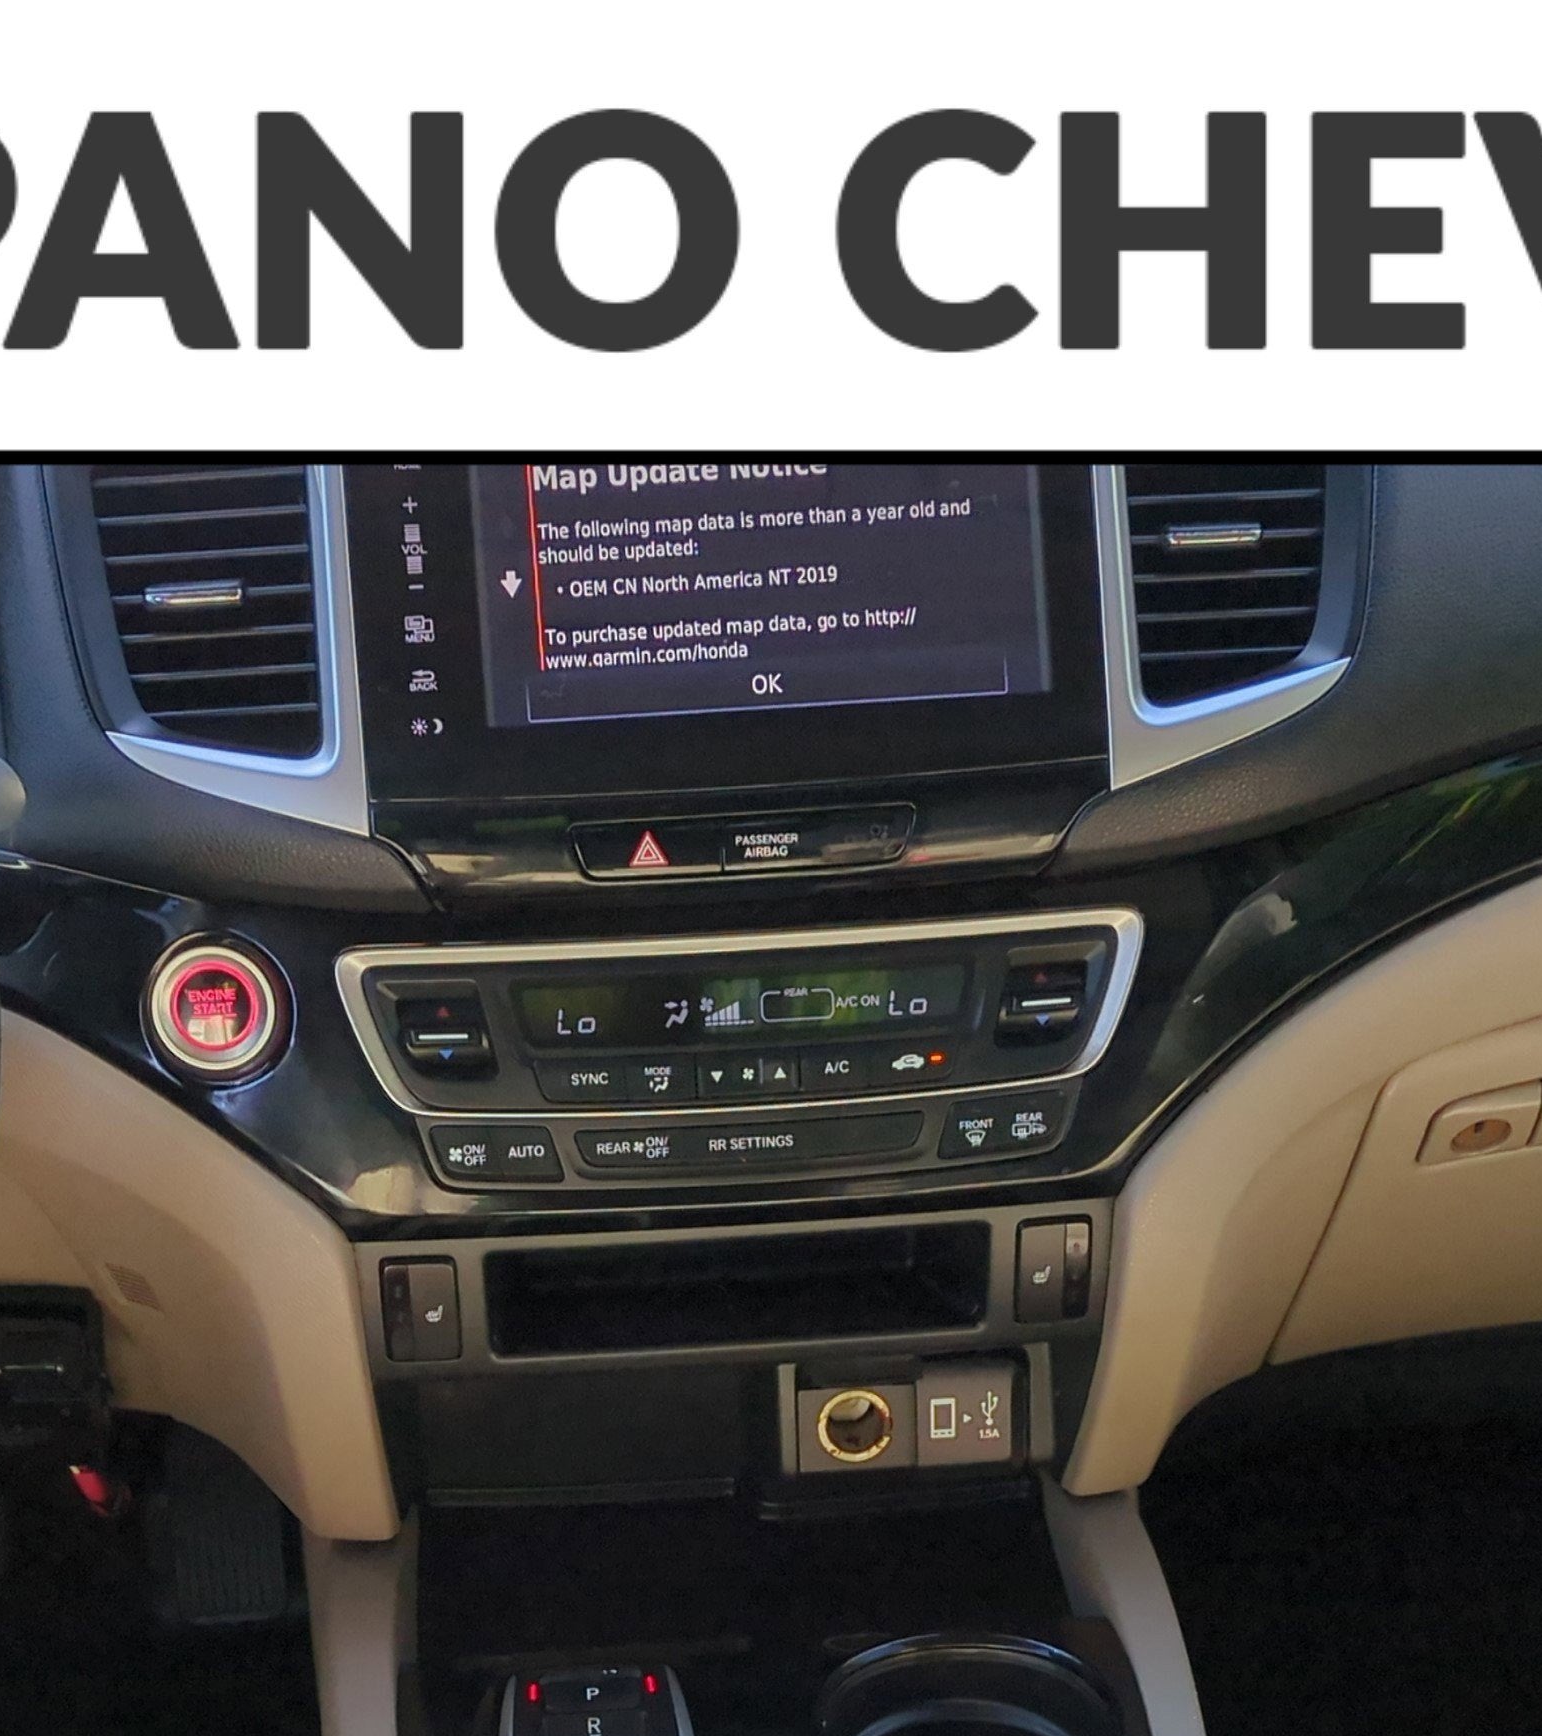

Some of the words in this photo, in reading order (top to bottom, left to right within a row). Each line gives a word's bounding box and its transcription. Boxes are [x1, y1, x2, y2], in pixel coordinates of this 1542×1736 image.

[533, 465, 597, 494] Map
[608, 464, 719, 492] Update
[537, 523, 569, 540] The
[575, 518, 650, 539] following
[655, 517, 693, 535] map
[698, 513, 734, 531] data
[741, 511, 754, 528] is
[760, 511, 804, 527] more
[809, 506, 846, 524] than
[851, 508, 861, 522] a
[867, 505, 904, 524] year
[910, 500, 935, 519] old
[940, 498, 971, 517] and
[401, 544, 428, 555] VOL
[538, 544, 593, 565] should
[598, 543, 619, 561] be
[624, 538, 699, 562] updated:
[570, 580, 607, 597] OEM
[613, 578, 637, 595] CN
[642, 576, 689, 594] North
[694, 570, 763, 591] America
[768, 569, 791, 586] NT
[797, 565, 838, 584] 2019
[545, 628, 567, 646] To
[572, 625, 647, 647] purchase
[653, 619, 721, 641] updated
[726, 619, 763, 636] map
[769, 615, 812, 633] data,
[817, 616, 837, 633] go
[843, 613, 860, 628] to
[865, 607, 917, 628] http://
[405, 633, 435, 643] MENU
[409, 681, 438, 692] BACK
[752, 673, 783, 695] OK
[735, 833, 799, 847] PASSENGER
[744, 846, 788, 859] AIRBAG
[187, 988, 237, 1003] ENGINE
[783, 987, 808, 998] REAR
[193, 1001, 234, 1015] START
[835, 996, 859, 1010] A/C
[860, 994, 880, 1008] ON
[644, 1066, 672, 1076] MODE
[824, 1060, 850, 1075] A/C
[571, 1072, 609, 1087] SYNC
[1015, 1111, 1043, 1122] REAR
[959, 1118, 994, 1131] FRONT
[596, 1141, 631, 1155] REAR
[645, 1136, 669, 1148] ON/
[708, 1137, 726, 1151] RR
[729, 1134, 794, 1150] SETTINGS
[463, 1144, 486, 1156] ON/
[508, 1145, 545, 1159] AUTO
[646, 1147, 670, 1159] OFF
[464, 1155, 487, 1167] OFF
[586, 1686, 600, 1701] P
[587, 1716, 601, 1735] R
